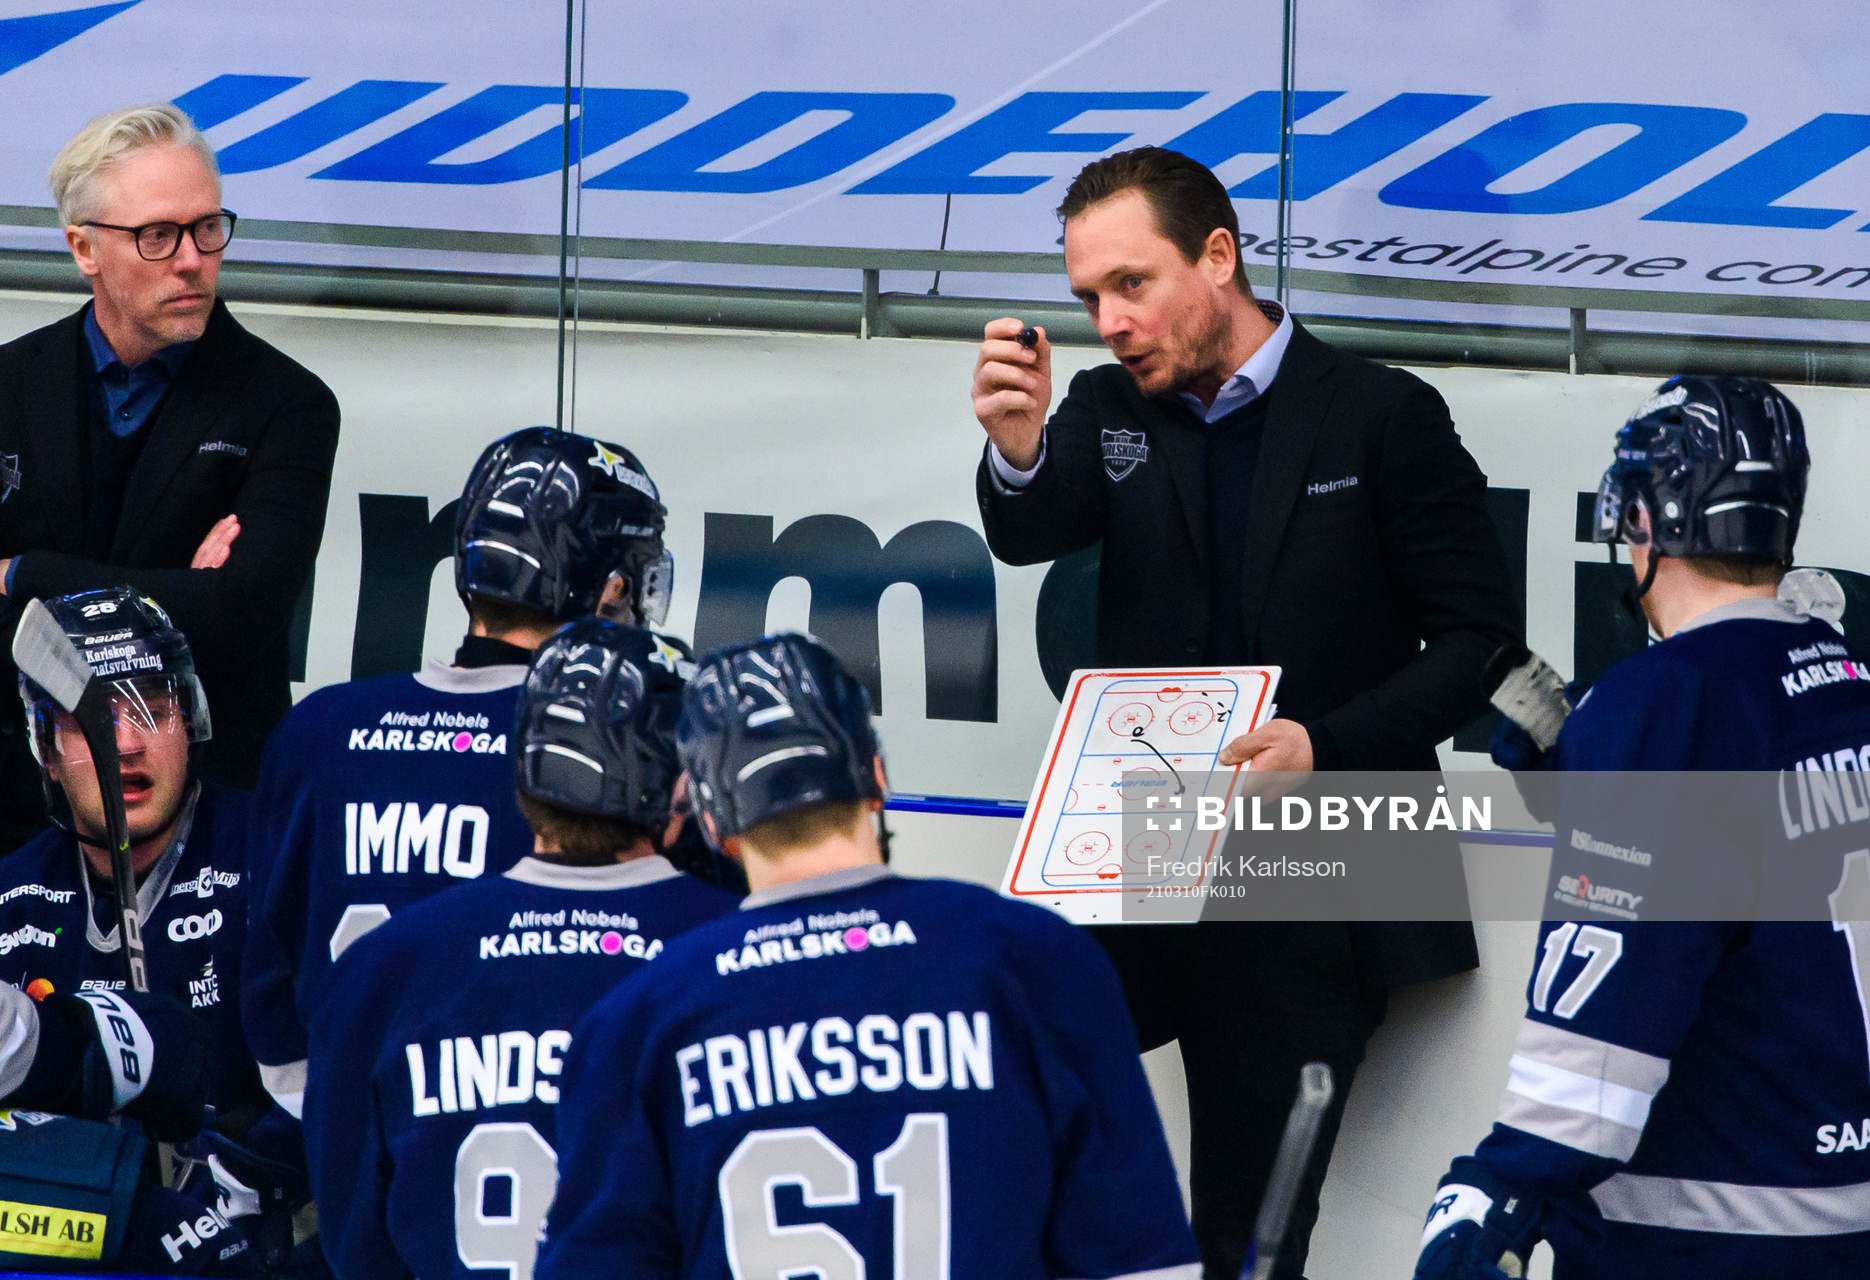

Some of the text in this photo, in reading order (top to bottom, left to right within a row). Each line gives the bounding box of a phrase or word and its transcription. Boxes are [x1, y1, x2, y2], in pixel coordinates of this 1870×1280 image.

[173, 73, 1870, 232] UDDEHOL
[198, 440, 248, 456] Helmia
[1307, 475, 1359, 496] Helmia
[85, 644, 137, 664] Karlskoga
[379, 711, 490, 730] Alfred Nobels
[348, 728, 508, 755] KARLSKOGA
[345, 802, 490, 880] IMMO
[508, 909, 639, 931] Alfred Nobels
[743, 917, 805, 944] Alfred
[715, 920, 918, 976] KARLSKOGA
[1533, 921, 1624, 1020] 17
[80, 980, 127, 991] BAUE
[675, 1011, 994, 1127] ERIKSSON
[717, 1111, 952, 1280] 61
[58, 1218, 95, 1243] AB
[160, 1207, 232, 1263] Hel
